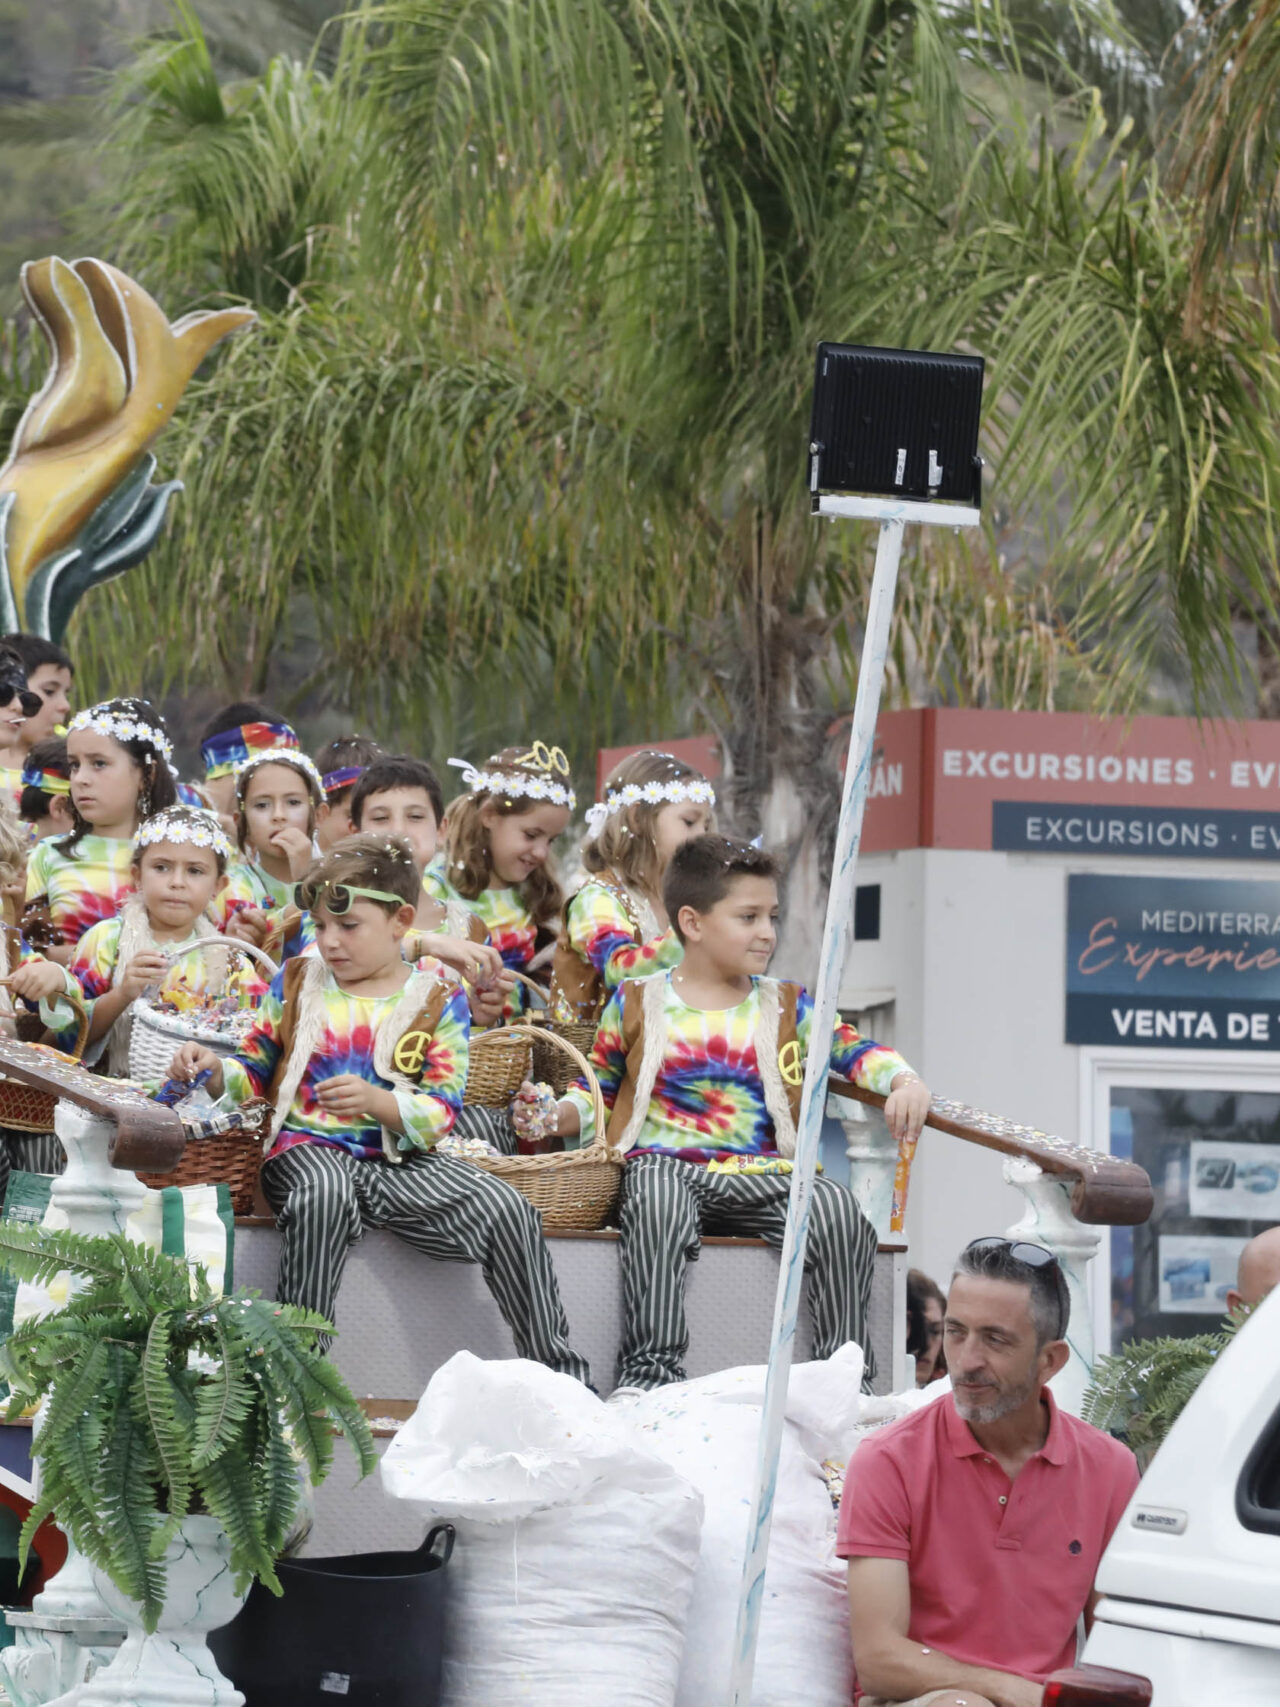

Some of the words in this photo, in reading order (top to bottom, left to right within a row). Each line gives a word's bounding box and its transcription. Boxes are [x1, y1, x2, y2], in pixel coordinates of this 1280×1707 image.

[866, 757, 903, 799] ÁN
[942, 750, 1194, 785] EXCURSIONES
[1230, 760, 1280, 788] EV
[1026, 817, 1219, 848] EXCURSIONS
[1111, 1008, 1218, 1039] VENTA
[1227, 1012, 1270, 1041] DE
